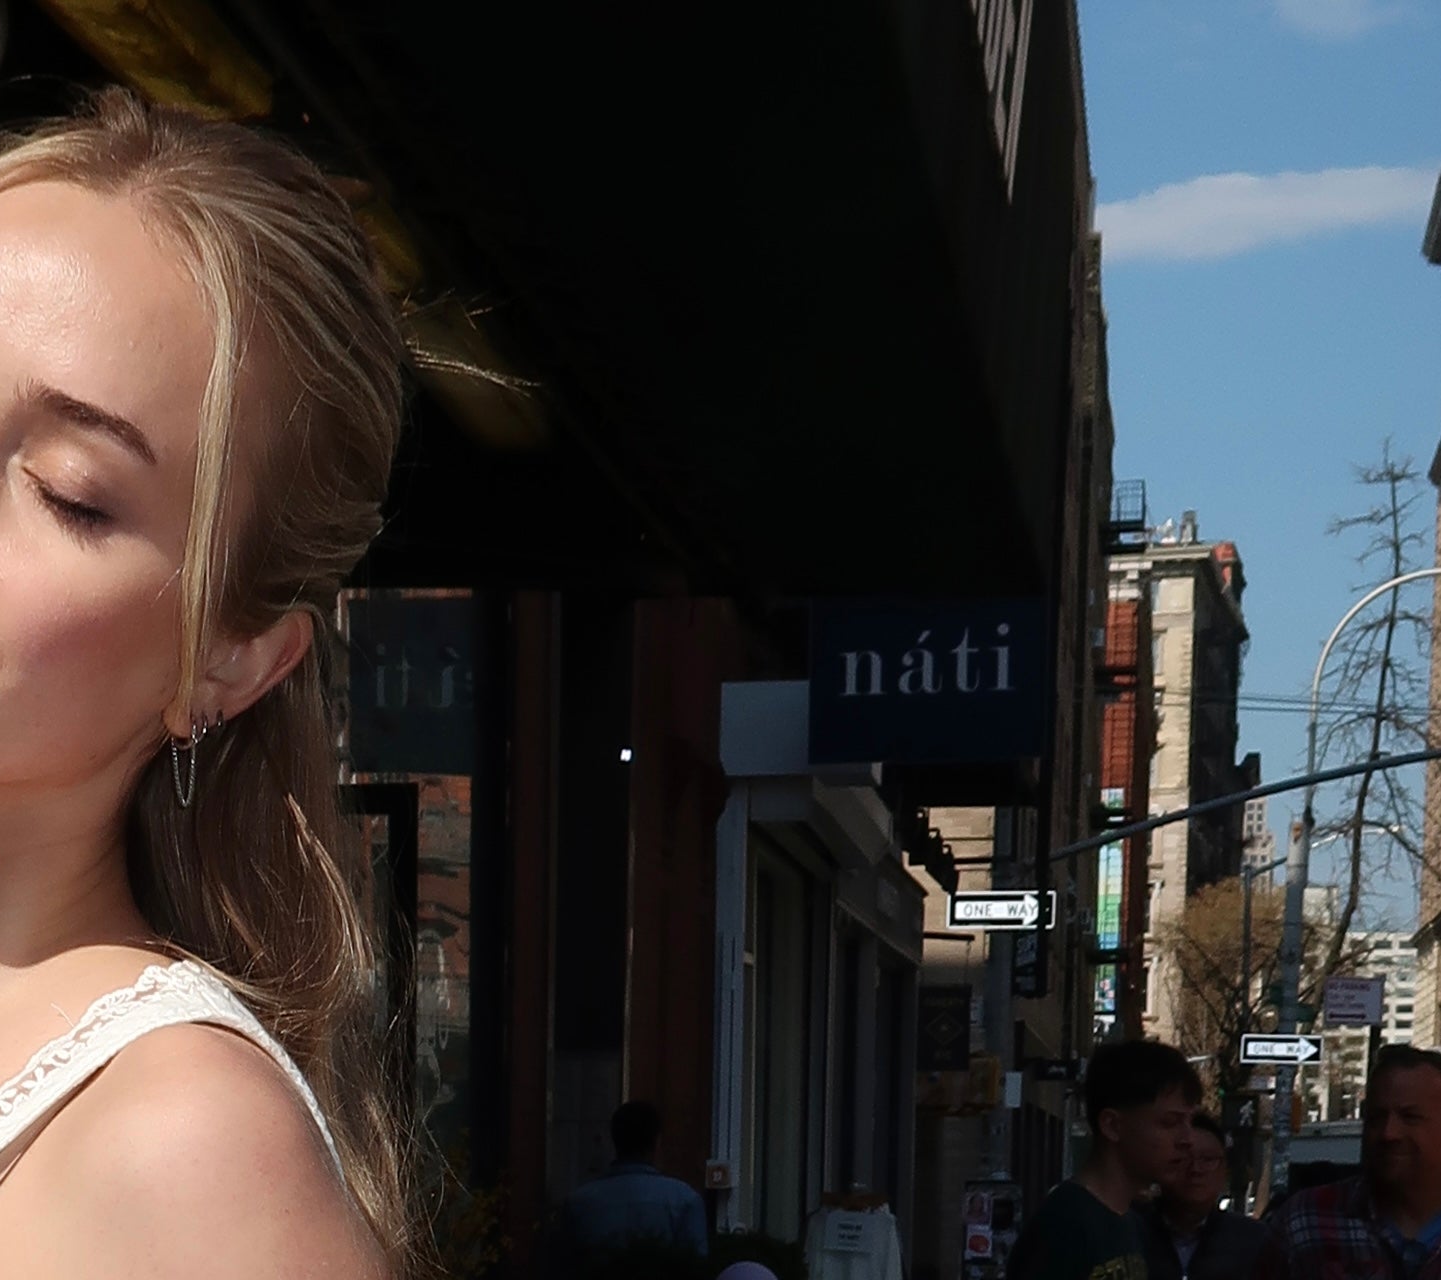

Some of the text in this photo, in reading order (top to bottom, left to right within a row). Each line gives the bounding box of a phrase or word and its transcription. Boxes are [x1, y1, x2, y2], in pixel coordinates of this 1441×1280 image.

[838, 621, 1016, 697] náti
[963, 902, 1039, 917] ONE WAY
[1253, 1042, 1311, 1055] ONE WAY
